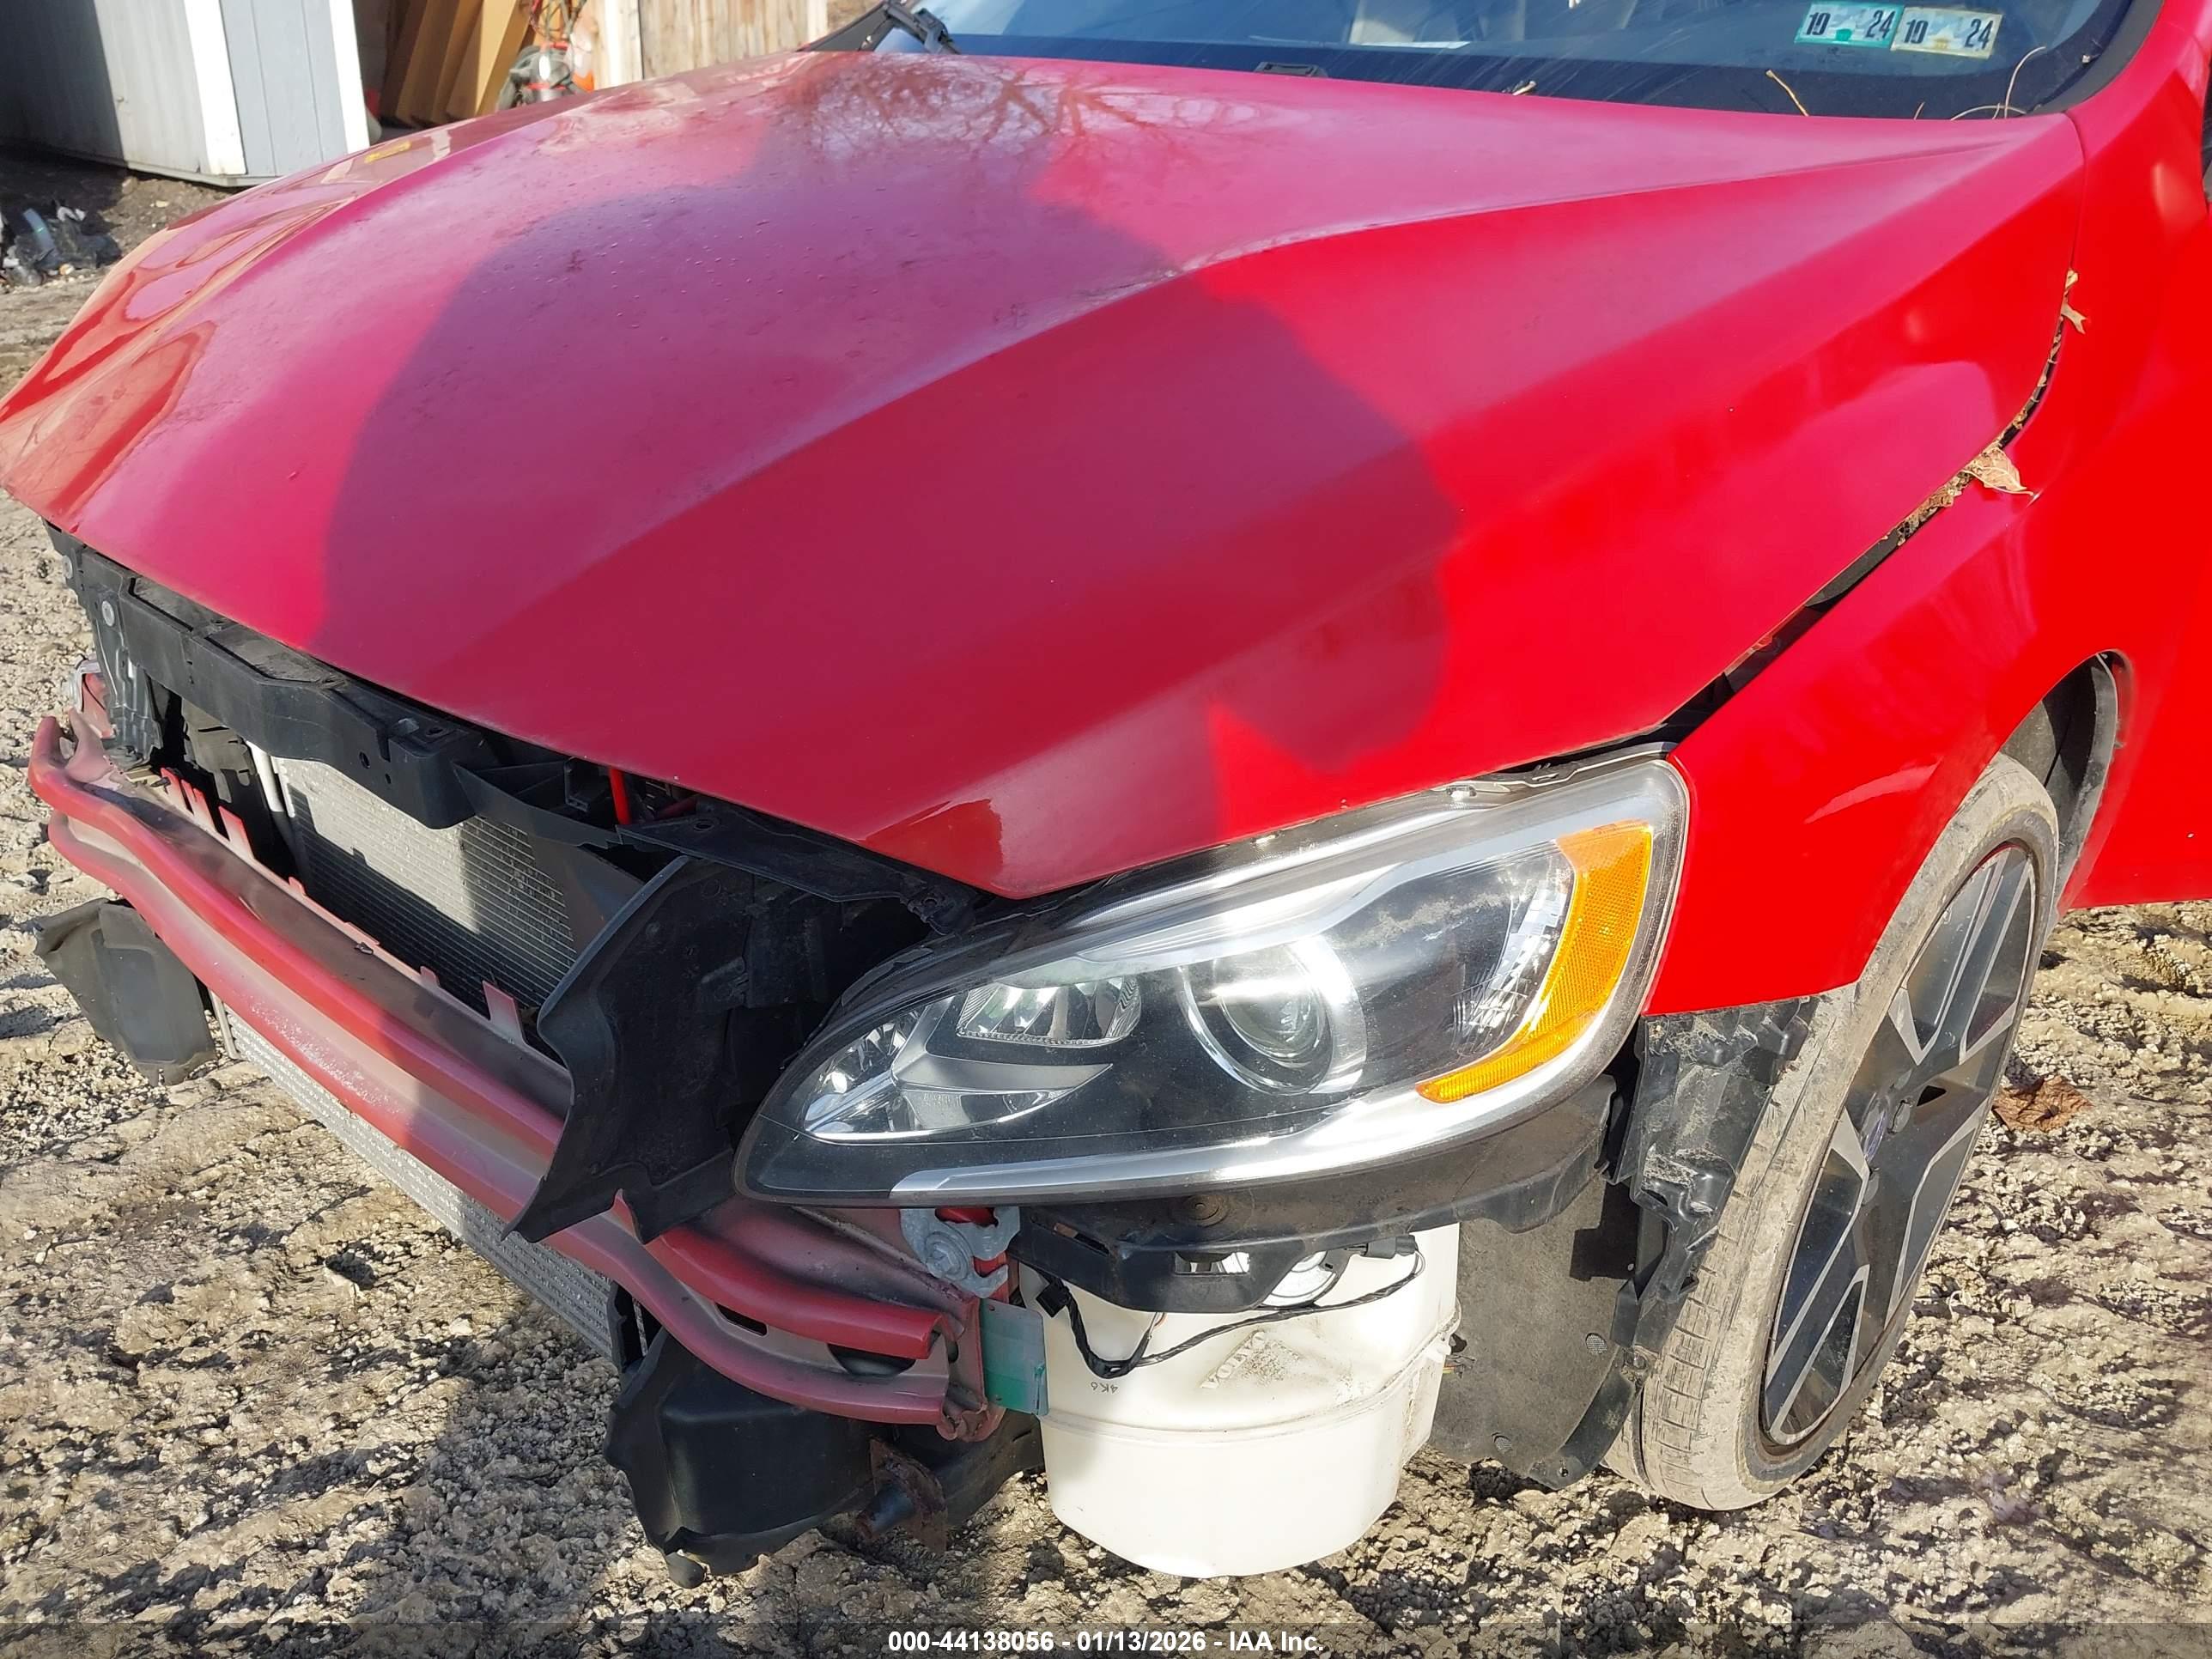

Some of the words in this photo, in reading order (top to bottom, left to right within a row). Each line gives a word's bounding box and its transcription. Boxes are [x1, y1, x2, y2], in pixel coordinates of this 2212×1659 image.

[1865, 10, 1895, 39] 24
[1965, 18, 1993, 49] 24
[1200, 1329, 1267, 1389] VOLVO
